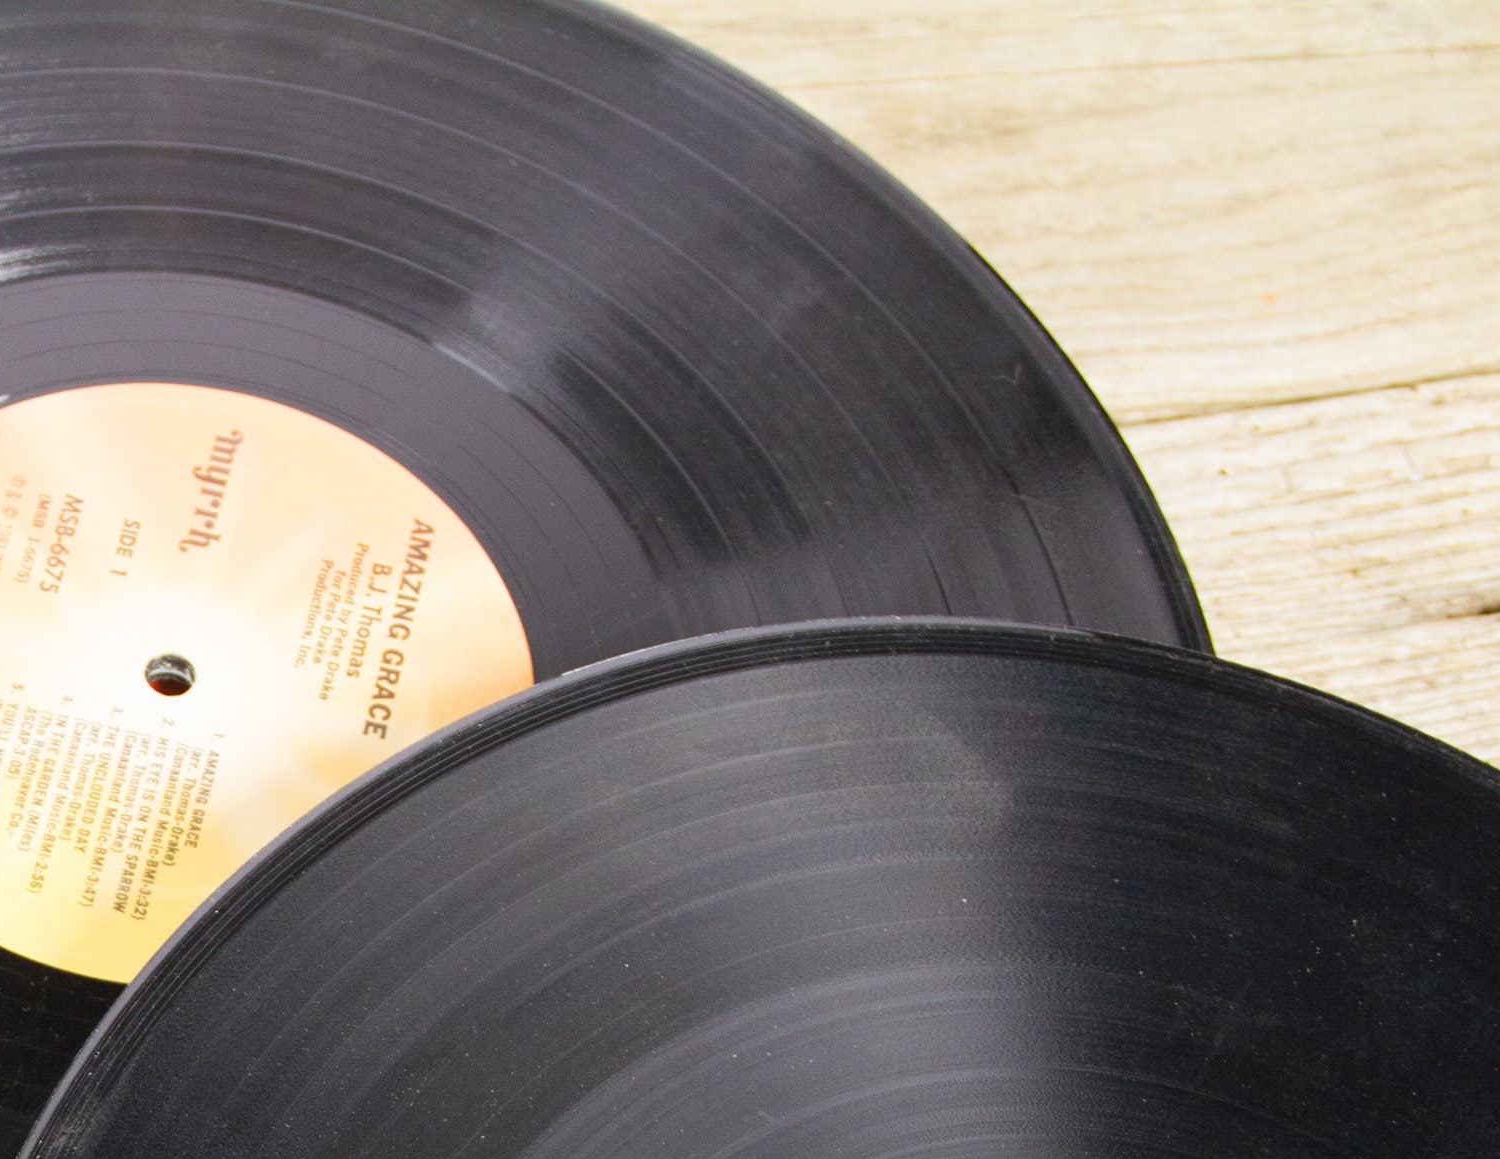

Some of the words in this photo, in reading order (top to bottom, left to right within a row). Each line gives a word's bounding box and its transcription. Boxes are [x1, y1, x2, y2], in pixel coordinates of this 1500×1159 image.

[177, 429, 243, 552] myrrh
[38, 493, 83, 593] MSB-6675
[115, 519, 140, 557] SIDE
[331, 570, 347, 590] for
[344, 542, 370, 605] Produced
[365, 562, 393, 597] B.J.
[387, 518, 434, 640] AMAZING
[300, 558, 335, 639] Productions,
[323, 591, 342, 621] Pete
[336, 608, 353, 624] by
[293, 644, 312, 668] Inc.
[312, 625, 332, 664] Drake
[329, 627, 348, 657] Pete
[345, 605, 382, 678] Thomas
[9, 682, 24, 695] 5.
[318, 661, 340, 700] Drake
[362, 649, 404, 740] GRACE
[102, 726, 120, 748] THE
[153, 736, 169, 758] HIS
[80, 753, 110, 825] UNCLOUDED
[145, 762, 163, 785] EYE
[194, 750, 219, 806] AMAZING
[141, 789, 156, 801] IS
[136, 805, 151, 823] ON
[183, 809, 204, 848] GRACE
[73, 828, 91, 853] DAY
[128, 827, 147, 851] THE
[112, 855, 138, 914] SPARROW
